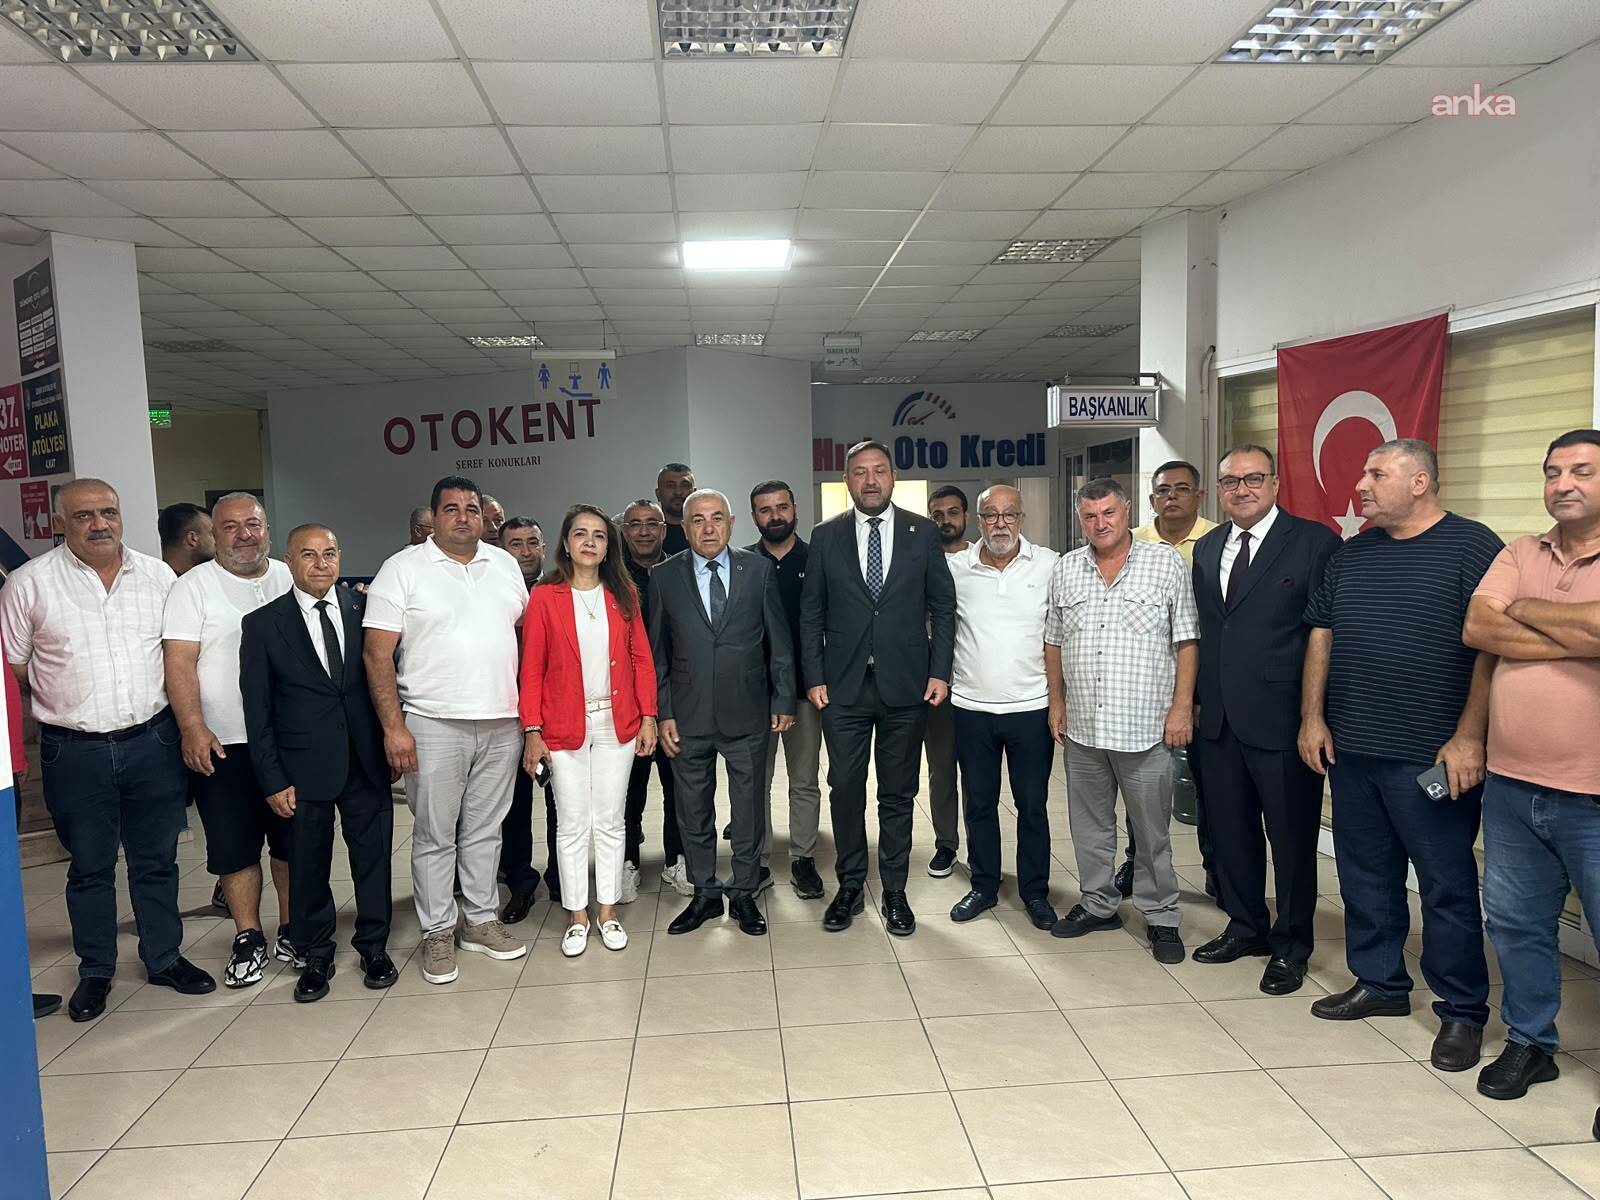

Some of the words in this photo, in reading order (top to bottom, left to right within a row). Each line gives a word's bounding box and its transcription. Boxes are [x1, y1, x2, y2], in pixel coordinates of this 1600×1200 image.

[34, 409, 59, 431] PLAKA
[1069, 396, 1147, 420] BAŞKANLIK
[383, 399, 601, 455] OTOKENT
[32, 430, 65, 457] ATÖLYESİ
[895, 436, 948, 470] Oto
[960, 433, 1046, 468] Kredi
[456, 459, 483, 471] ŞEREF
[488, 455, 541, 468] KONUKLARI
